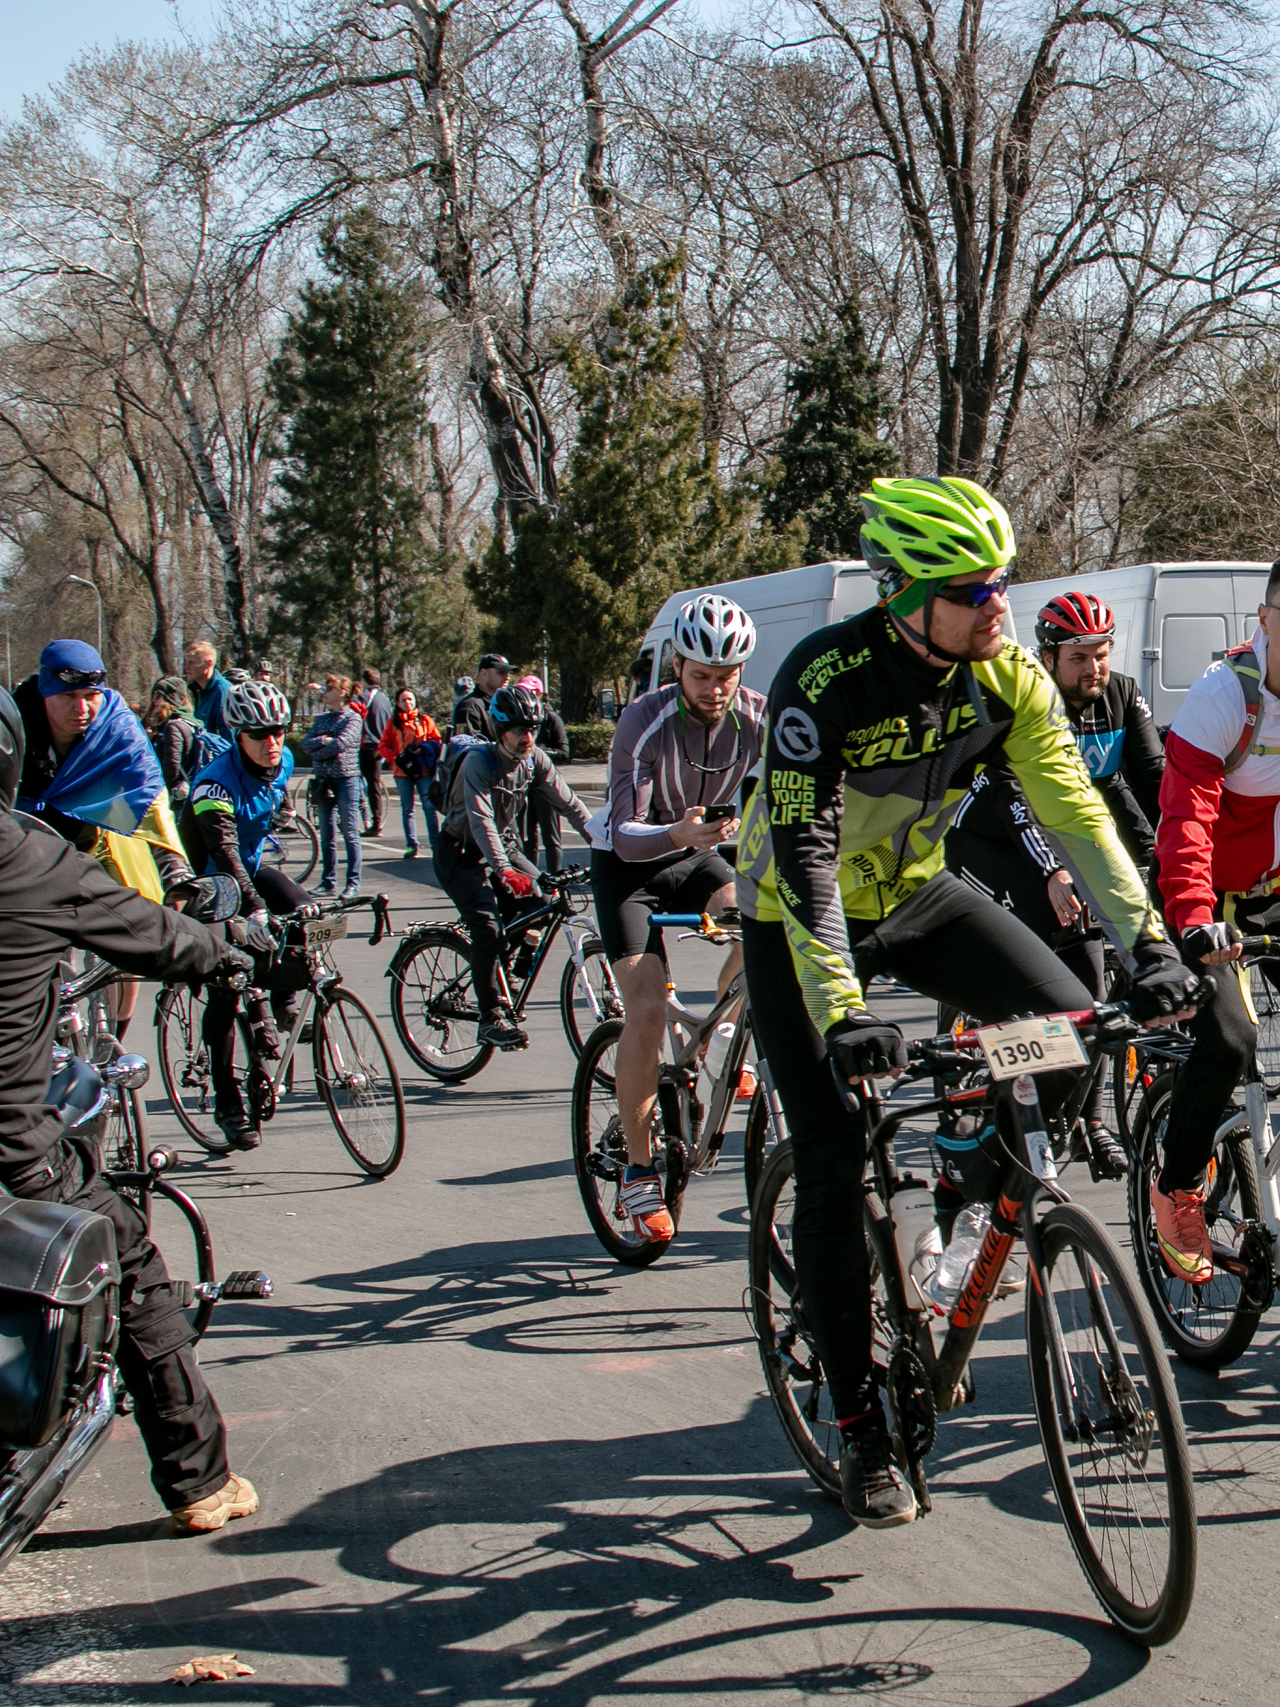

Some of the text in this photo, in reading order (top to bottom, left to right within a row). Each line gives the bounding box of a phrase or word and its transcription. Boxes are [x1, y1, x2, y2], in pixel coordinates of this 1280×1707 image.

[798, 648, 841, 691] PRORACE
[771, 770, 816, 791] RIDE
[972, 771, 989, 793] sky
[771, 789, 816, 805] YOUR
[770, 803, 816, 825] LIFE
[1010, 801, 1029, 825] sky
[848, 853, 877, 885] RIDE
[308, 928, 332, 943] 209
[991, 1040, 1044, 1068] 1390
